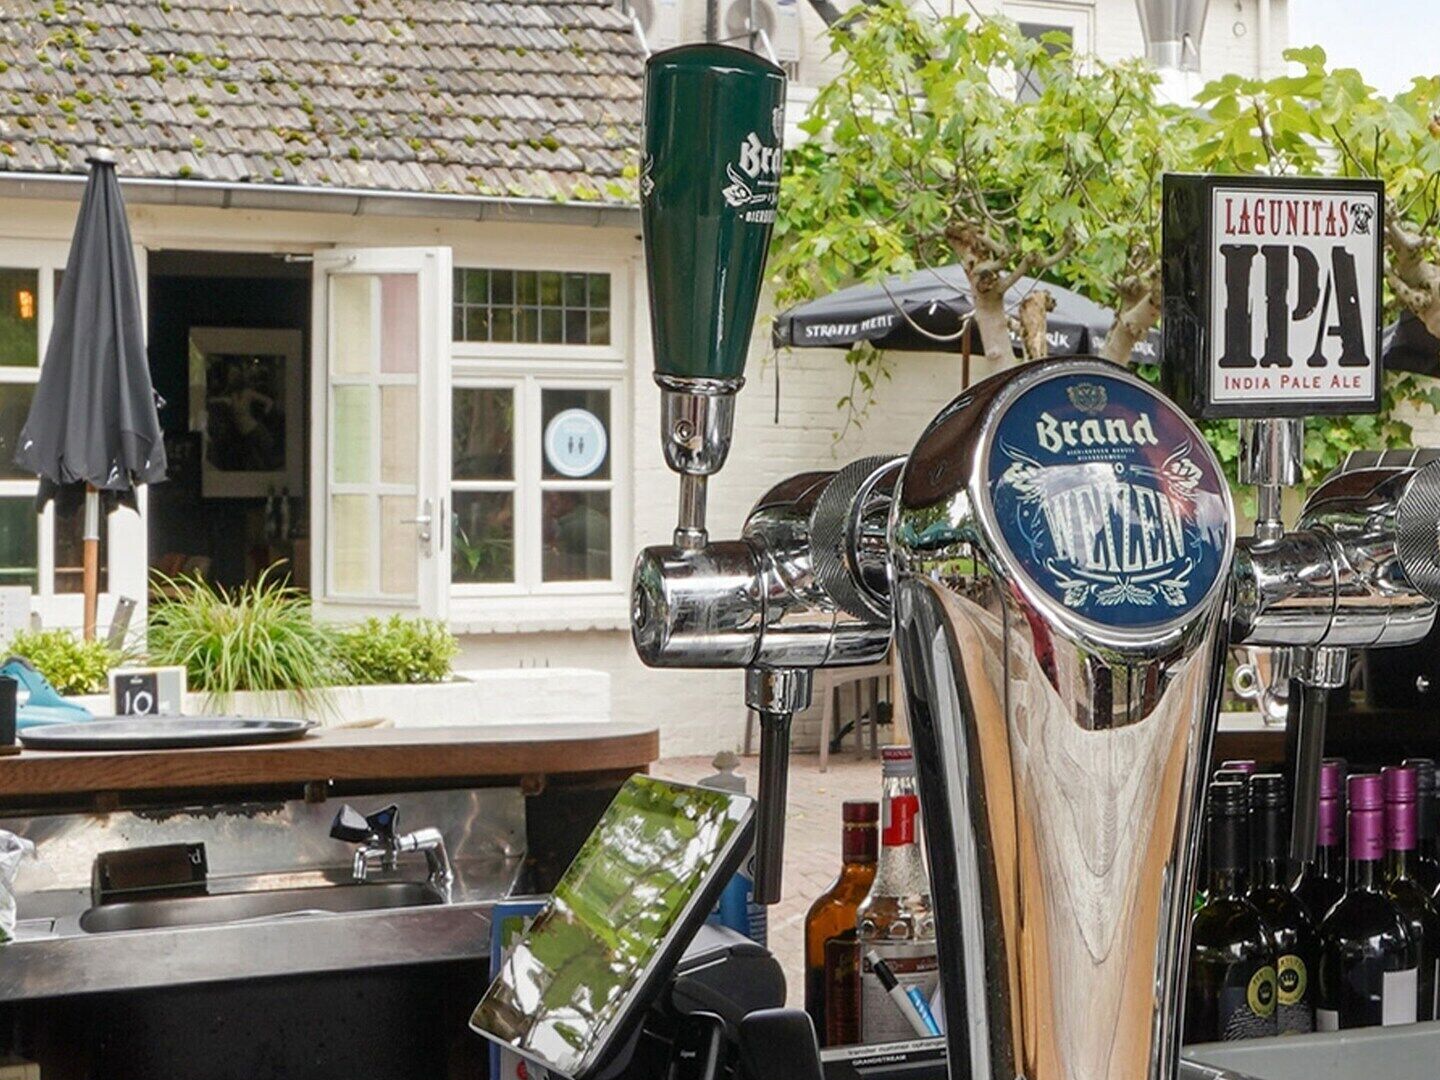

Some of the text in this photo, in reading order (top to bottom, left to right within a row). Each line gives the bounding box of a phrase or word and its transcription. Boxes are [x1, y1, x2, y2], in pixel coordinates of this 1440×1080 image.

[1225, 199, 1349, 237] LAGUNITAS
[1218, 244, 1370, 368] IPA
[1225, 375, 1361, 390] INDIA PALE ALE
[1036, 412, 1159, 453] Brand
[1043, 481, 1185, 572] WEIZEN
[125, 690, 153, 715] 10
